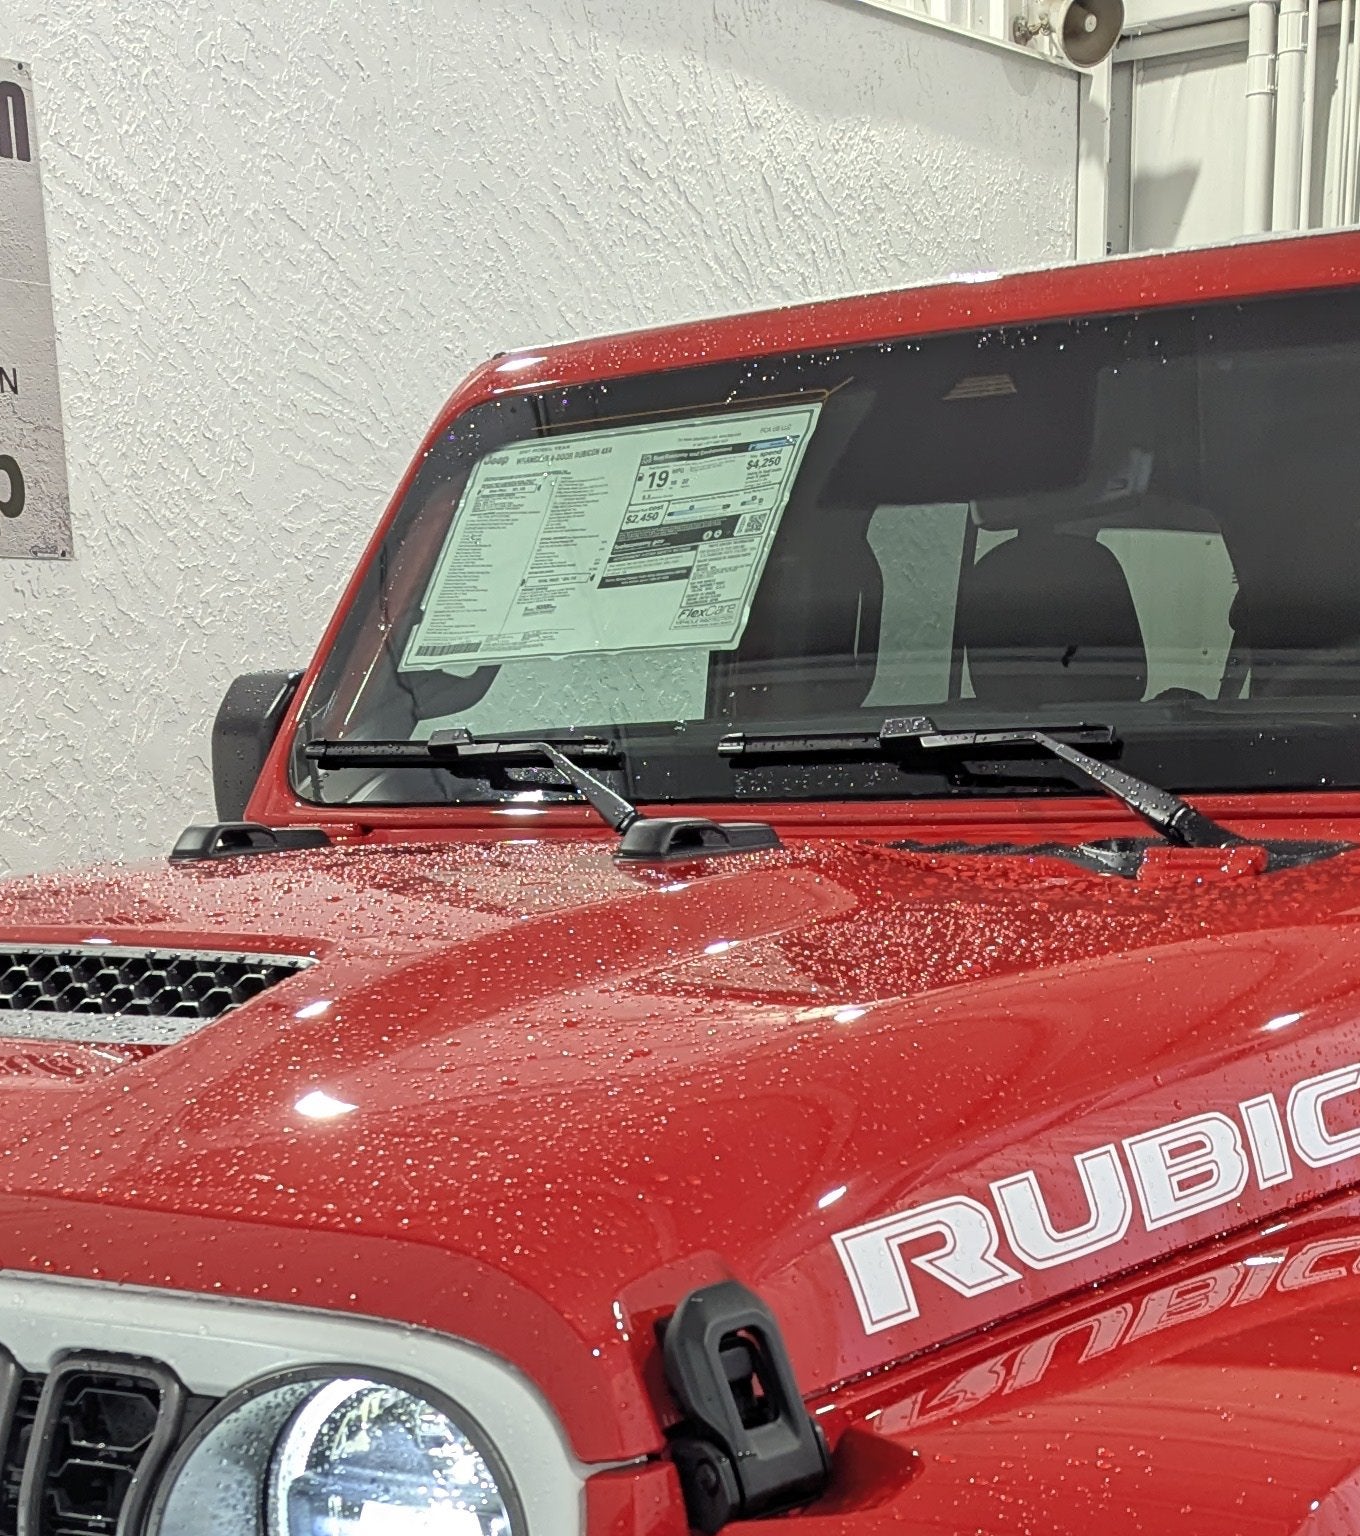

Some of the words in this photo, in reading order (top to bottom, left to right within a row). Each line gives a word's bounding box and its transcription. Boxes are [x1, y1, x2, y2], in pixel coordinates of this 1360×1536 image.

[746, 456, 782, 471] $4,250
[648, 470, 670, 489] 19
[625, 512, 659, 524] $2,450
[677, 603, 737, 619] FlexCare
